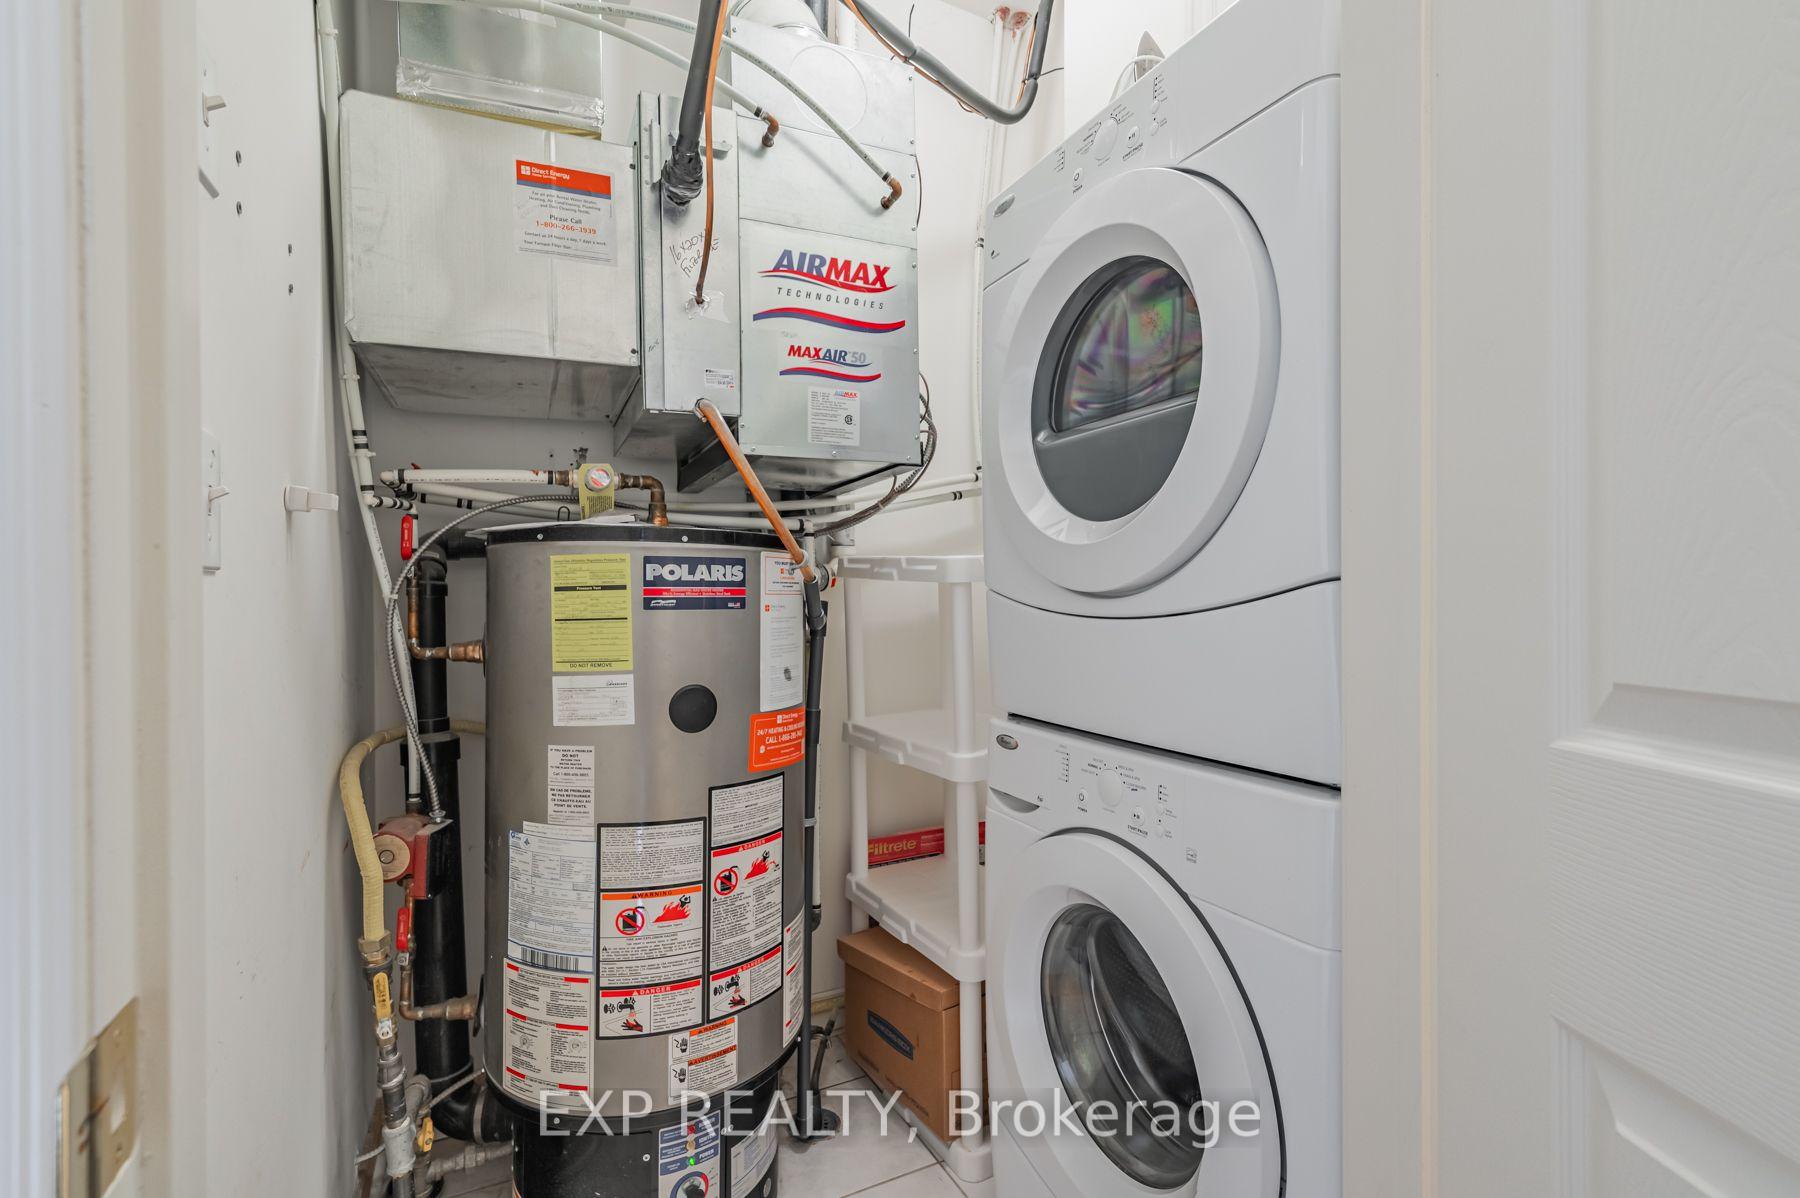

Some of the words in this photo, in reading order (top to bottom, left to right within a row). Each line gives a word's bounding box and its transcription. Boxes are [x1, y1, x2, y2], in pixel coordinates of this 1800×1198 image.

[531, 166, 549, 175] Direct
[550, 170, 570, 180] Energy
[549, 213, 569, 222] Please
[570, 217, 582, 225] Call
[773, 249, 891, 289] AIRMAX
[777, 286, 884, 310] TECHNOLOGIES
[645, 563, 744, 582] POLARIS
[756, 728, 768, 736] 24/7
[765, 735, 778, 745] CALL
[744, 839, 766, 851] DANGER
[637, 890, 673, 899] WARNING
[742, 957, 765, 971] DANGER
[639, 986, 671, 996] DANGER
[704, 1020, 727, 1032] WARNING
[692, 1044, 737, 1065] AVERTISSEMENT
